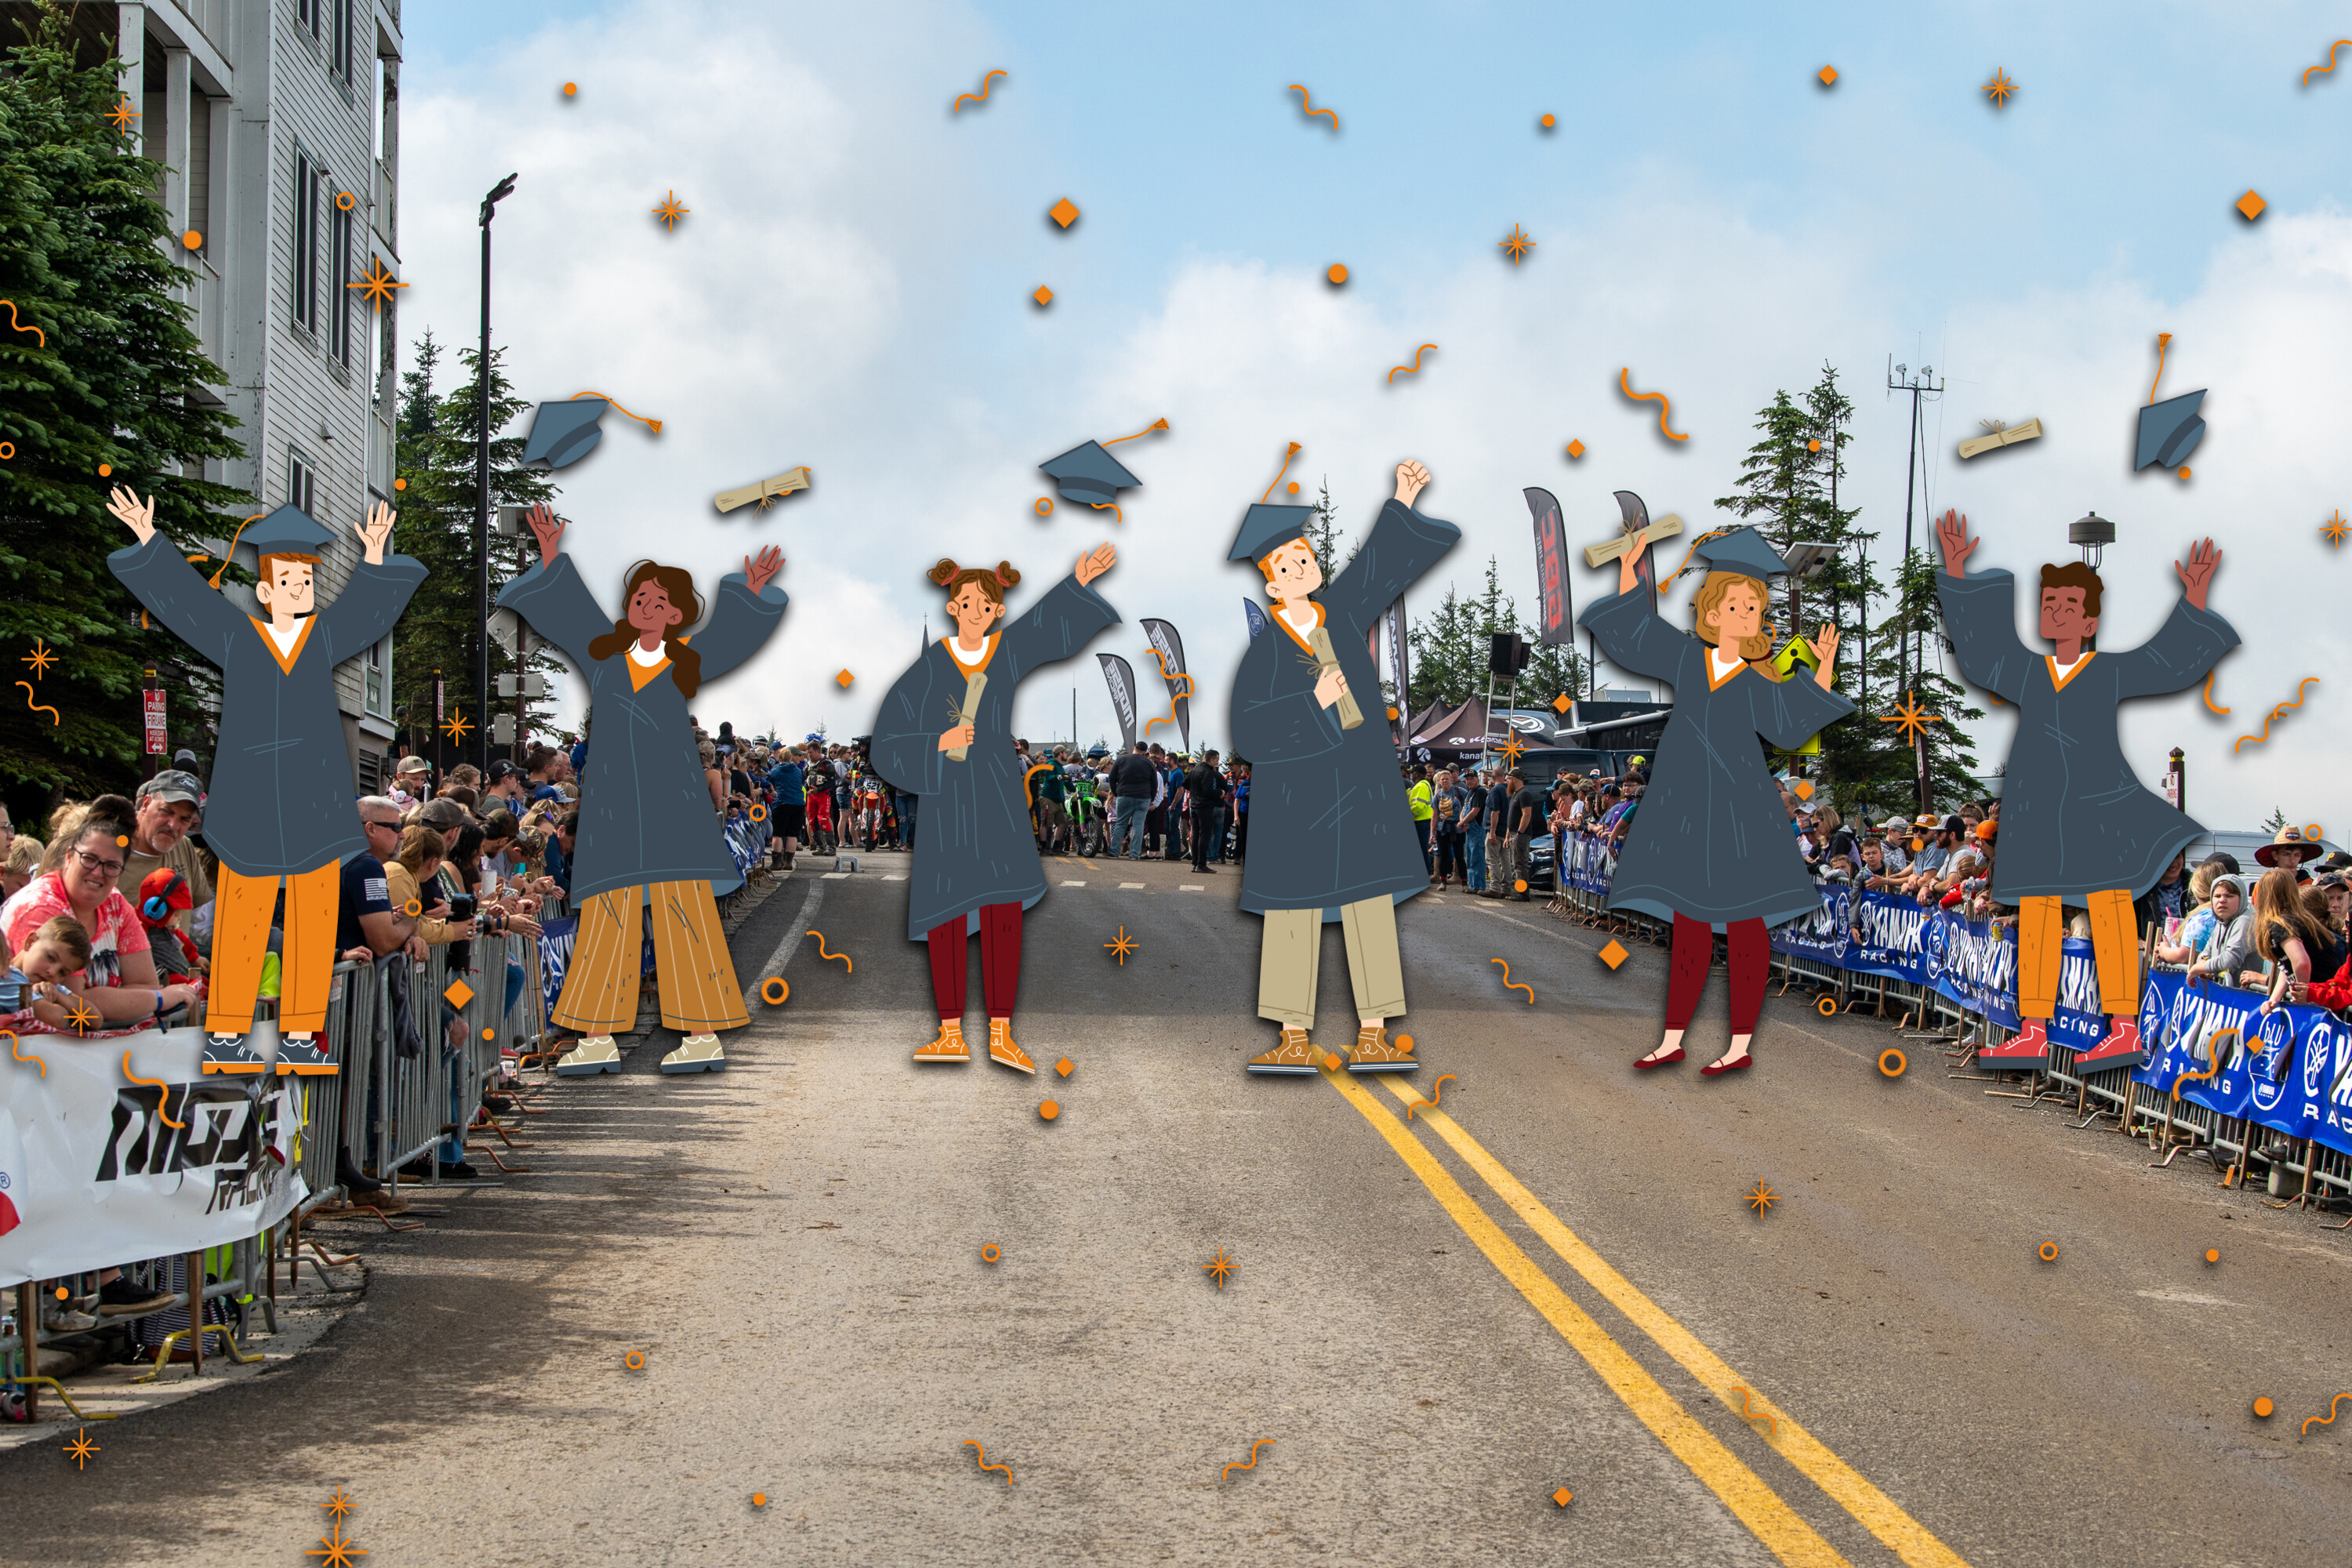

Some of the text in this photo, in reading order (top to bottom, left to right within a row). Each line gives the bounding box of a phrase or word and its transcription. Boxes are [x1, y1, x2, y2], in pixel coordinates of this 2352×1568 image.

[866, 782, 880, 790] 521
[1871, 905, 1924, 954] YAMAHA
[2048, 1016, 2100, 1037] ACING
[2302, 1102, 2352, 1135] RAC
